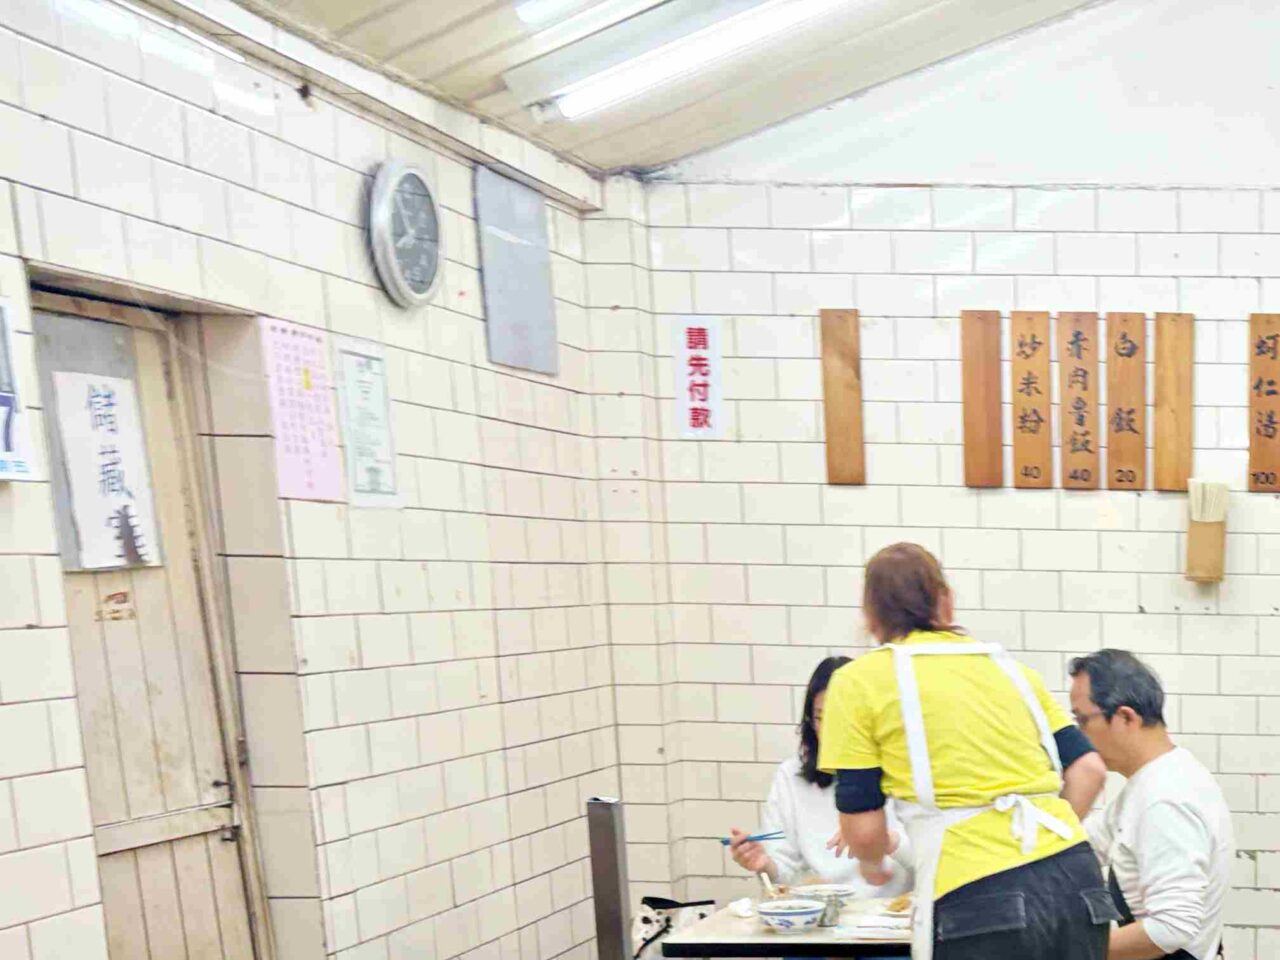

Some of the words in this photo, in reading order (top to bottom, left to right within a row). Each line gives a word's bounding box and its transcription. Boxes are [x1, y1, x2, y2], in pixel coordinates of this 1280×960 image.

[685, 326, 712, 429] 請先付款
[1111, 331, 1140, 434] 白飯
[1020, 465, 1042, 480] 40
[1068, 468, 1092, 482] 40
[1115, 468, 1137, 483] 20
[1251, 471, 1278, 486] 100
